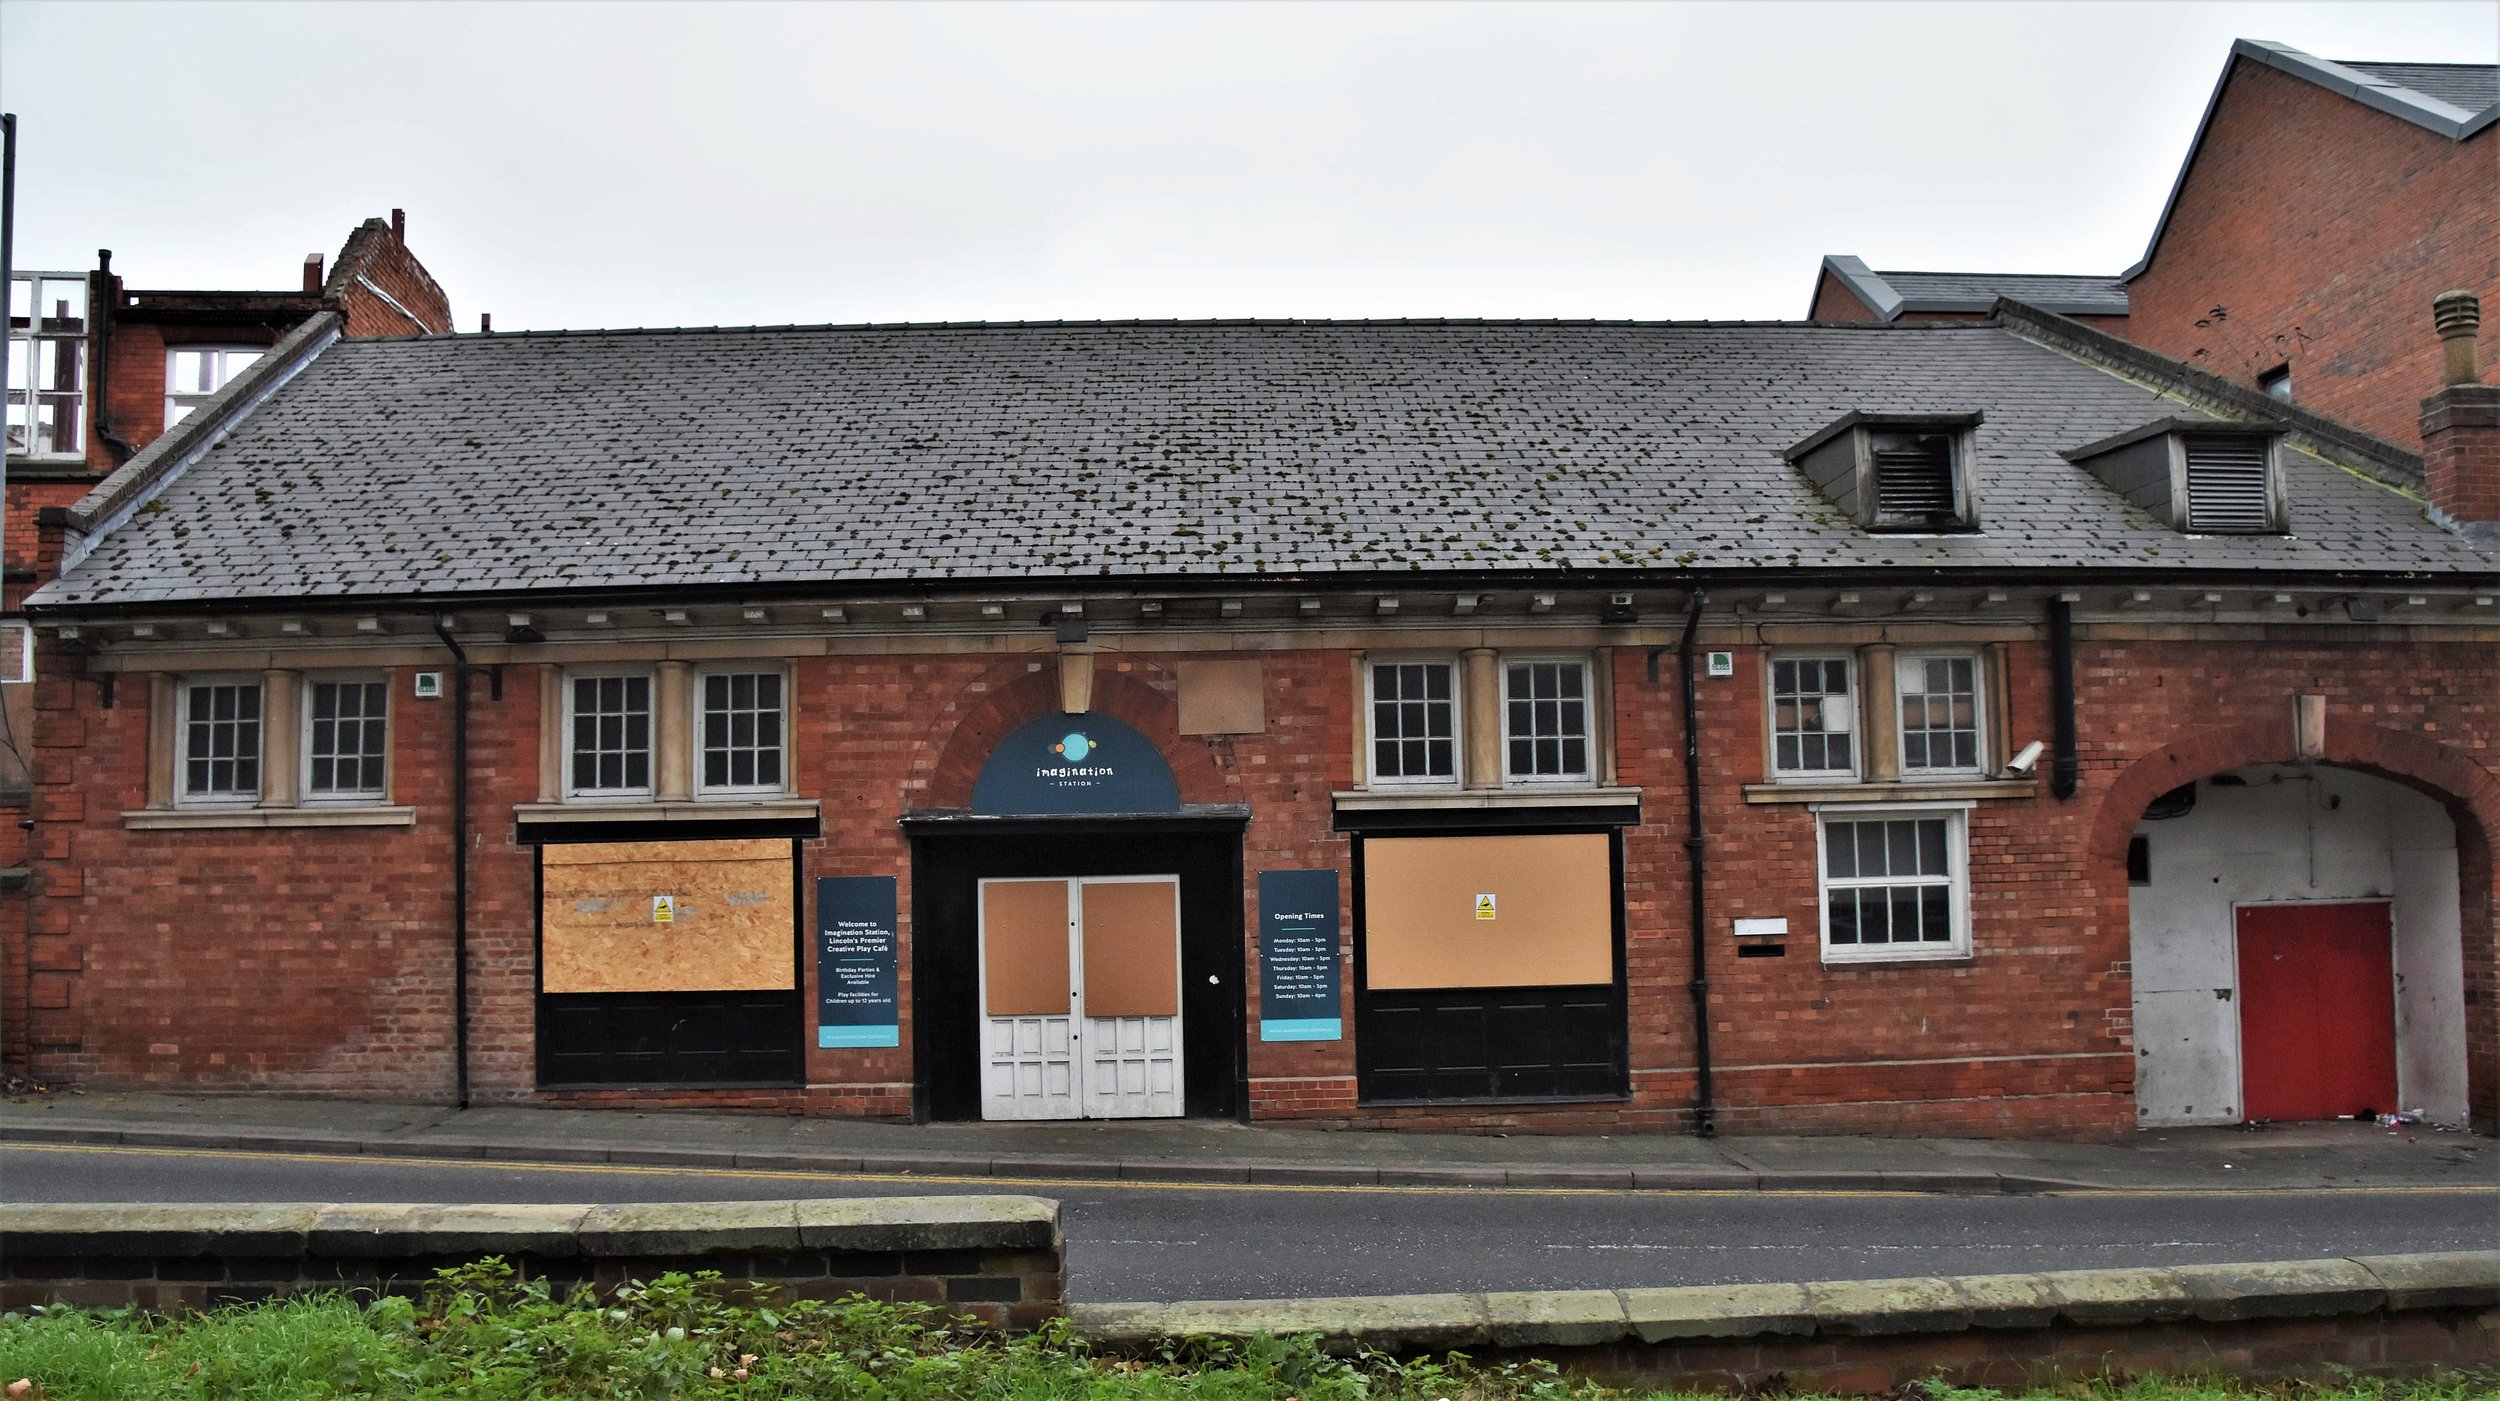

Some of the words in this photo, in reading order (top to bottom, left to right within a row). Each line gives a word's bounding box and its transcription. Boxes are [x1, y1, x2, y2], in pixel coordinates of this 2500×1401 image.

[1036, 767, 1114, 778] imagination
[1274, 913, 1303, 921] Opening
[824, 929, 864, 938] Imagination
[864, 928, 891, 936] Station,
[856, 945, 871, 953] Play
[872, 944, 889, 952] Café
[1273, 983, 1298, 991] Saturday:
